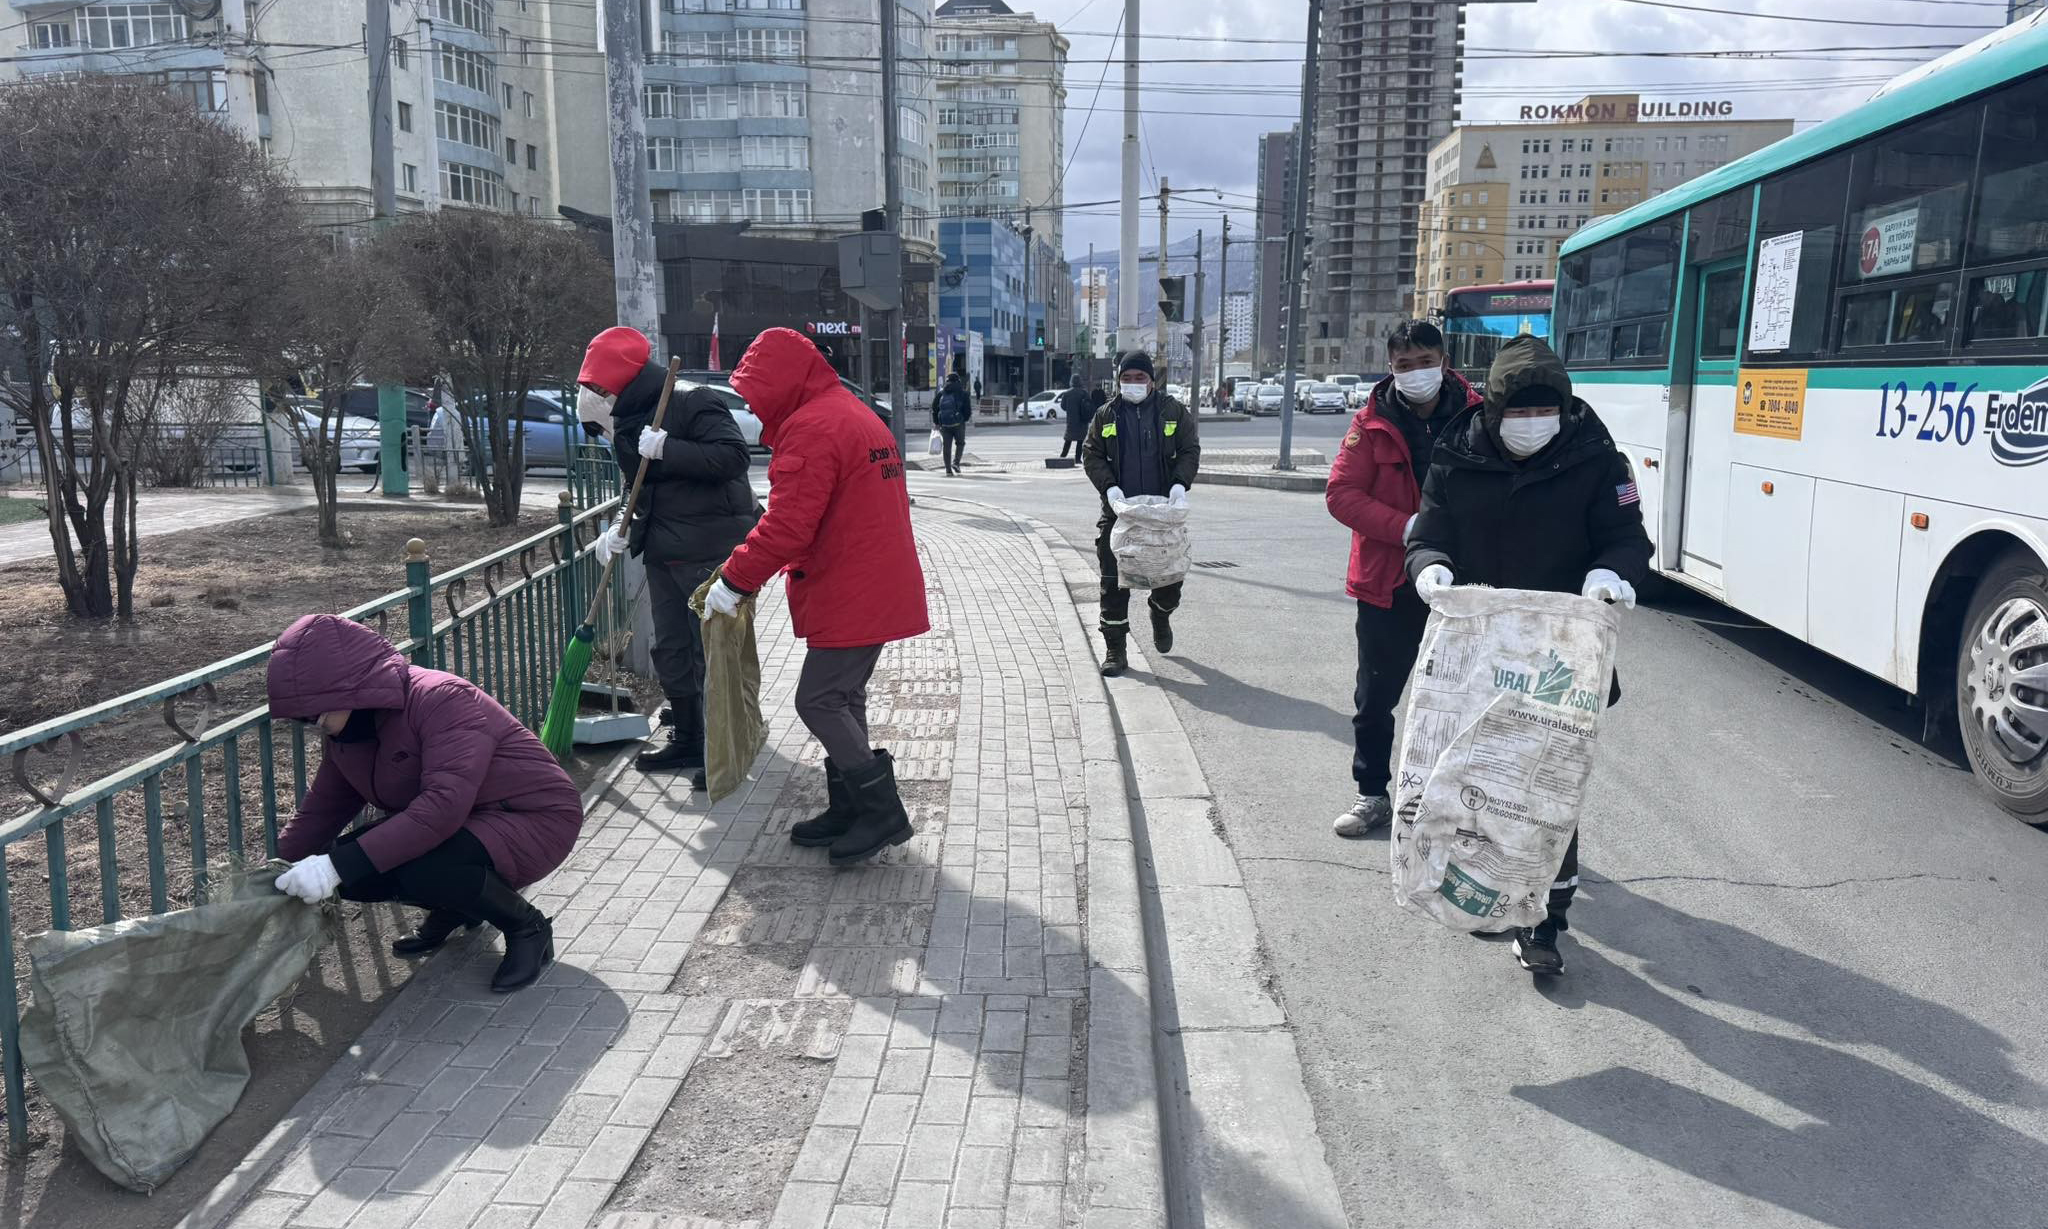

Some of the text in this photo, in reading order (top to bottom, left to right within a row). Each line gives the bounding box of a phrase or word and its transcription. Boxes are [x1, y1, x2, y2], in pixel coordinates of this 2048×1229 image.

[1520, 101, 1733, 119] ROKMON BUILDING
[816, 321, 862, 334] next.m
[1876, 381, 1978, 446] 13-256
[1493, 668, 1532, 694] URAL
